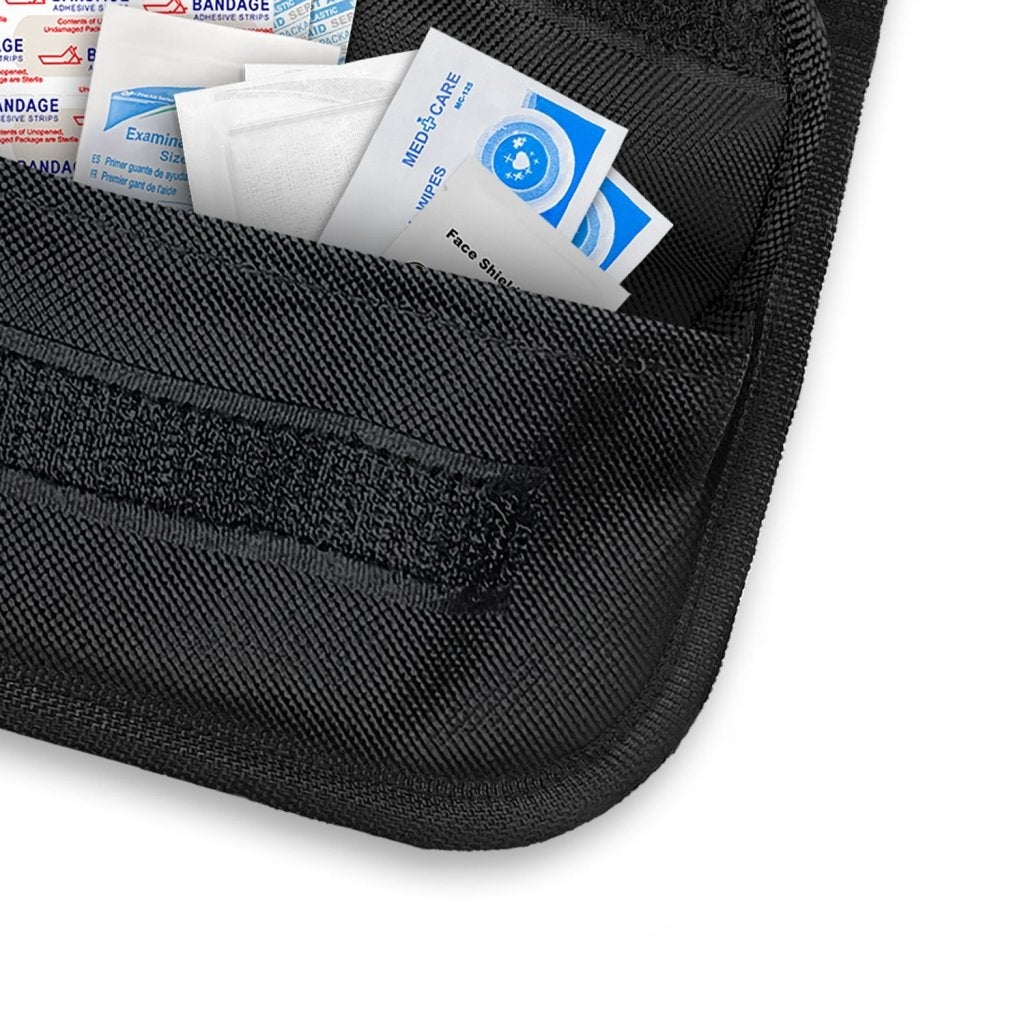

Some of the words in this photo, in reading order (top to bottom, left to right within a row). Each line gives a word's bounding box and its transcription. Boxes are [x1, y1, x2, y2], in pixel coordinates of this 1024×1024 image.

[52, 4, 95, 12] ADHESIVE
[238, 13, 270, 21] STRIPS
[28, 115, 59, 123] STRIPS
[104, 156, 128, 169] Primer
[154, 168, 164, 178] de
[101, 170, 128, 185] Premier
[146, 182, 156, 192] de
[415, 166, 447, 212] WIPES
[445, 228, 478, 260] Face
[478, 258, 520, 290] Shiel
